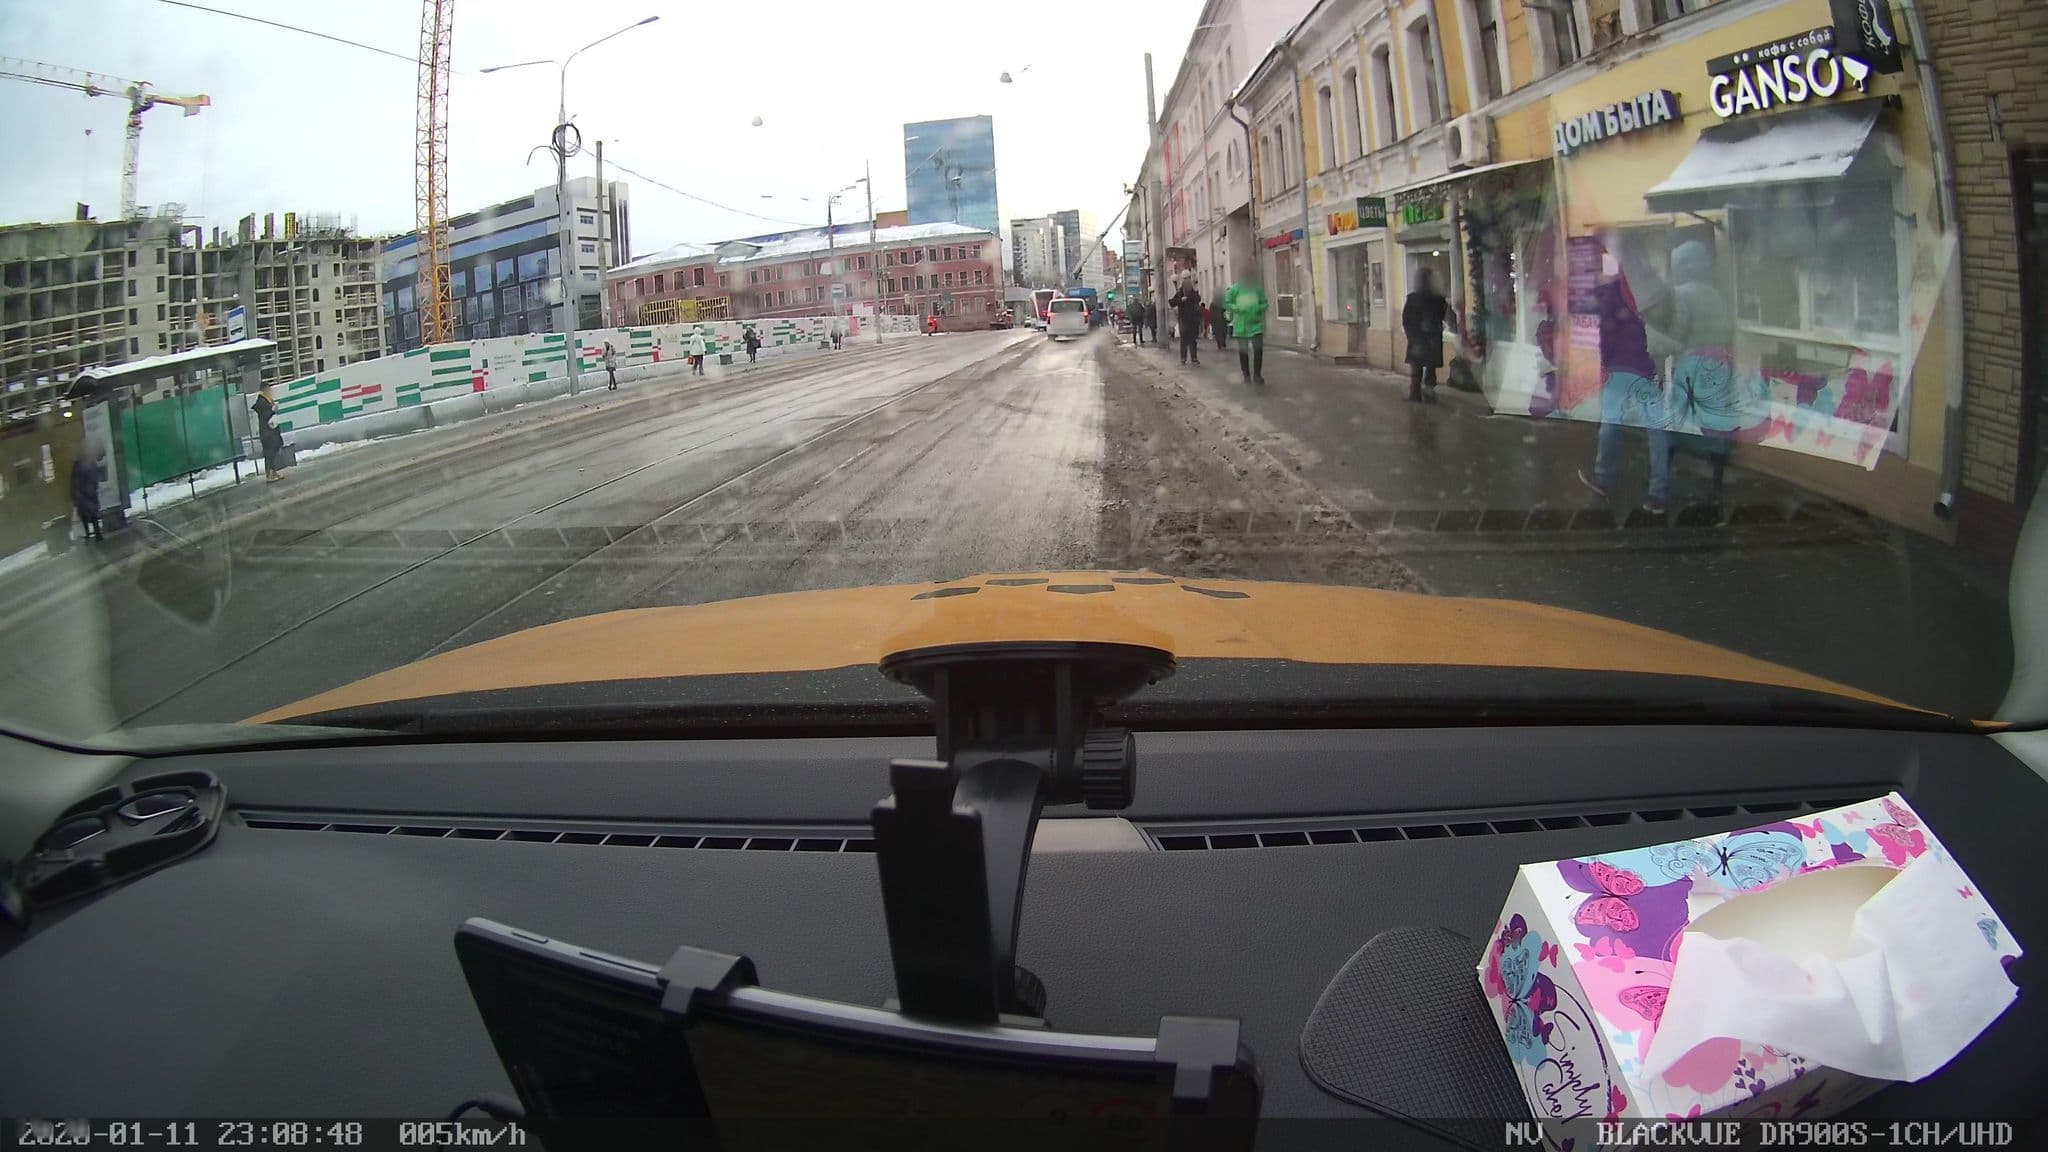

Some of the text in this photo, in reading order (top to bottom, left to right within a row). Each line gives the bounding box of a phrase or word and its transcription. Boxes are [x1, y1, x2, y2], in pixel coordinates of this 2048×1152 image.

[1758, 29, 1831, 58] кофе с собой
[1709, 48, 1840, 118] GANSO
[1553, 88, 1674, 155] ДОМ БЫТА
[1548, 1010, 1600, 1125] Simply
